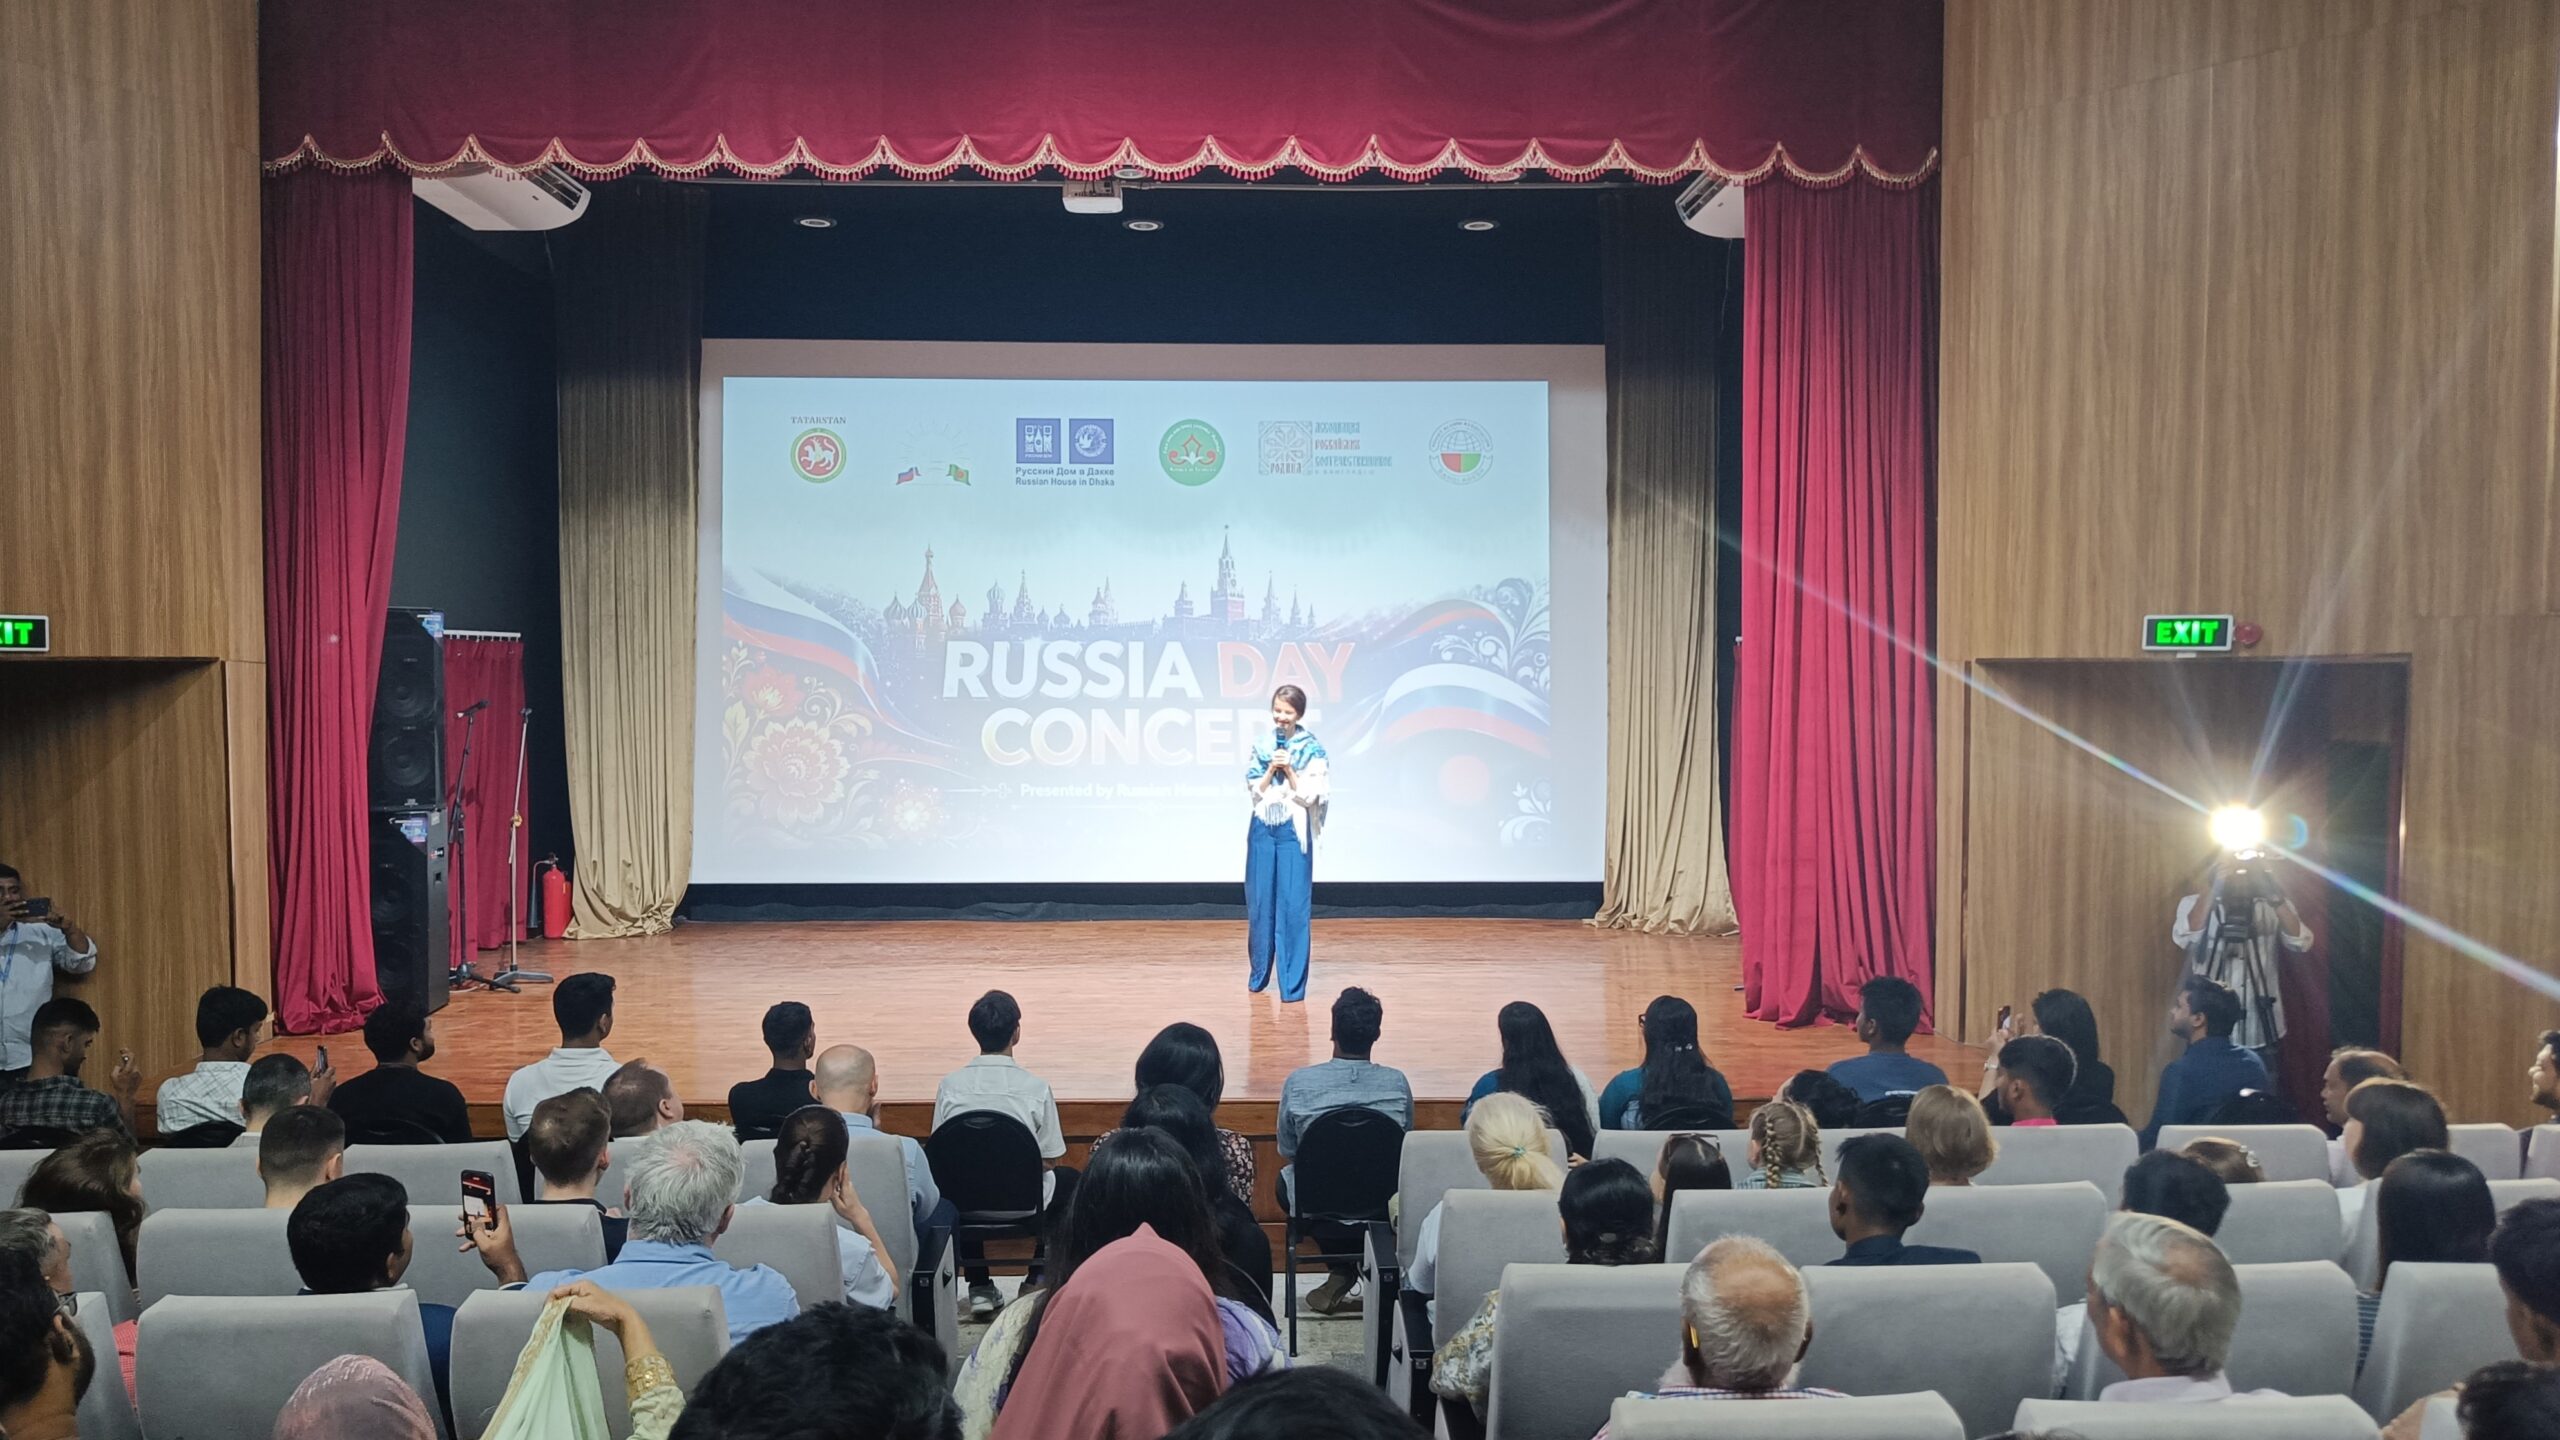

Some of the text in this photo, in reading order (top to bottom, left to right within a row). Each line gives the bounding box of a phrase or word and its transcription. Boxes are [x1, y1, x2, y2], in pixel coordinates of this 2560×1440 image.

[791, 415, 847, 425] TATARSTAN
[1015, 466, 1055, 477] Русский
[1056, 467, 1077, 477] Дом
[1087, 467, 1115, 477] Дакке
[1015, 477, 1115, 487] Russian House in Dhaka
[2156, 620, 2219, 644] EXIT
[942, 640, 1356, 703] RUSSIA DAY
[1020, 783, 1092, 797] Presented
[1096, 783, 1114, 799] by
